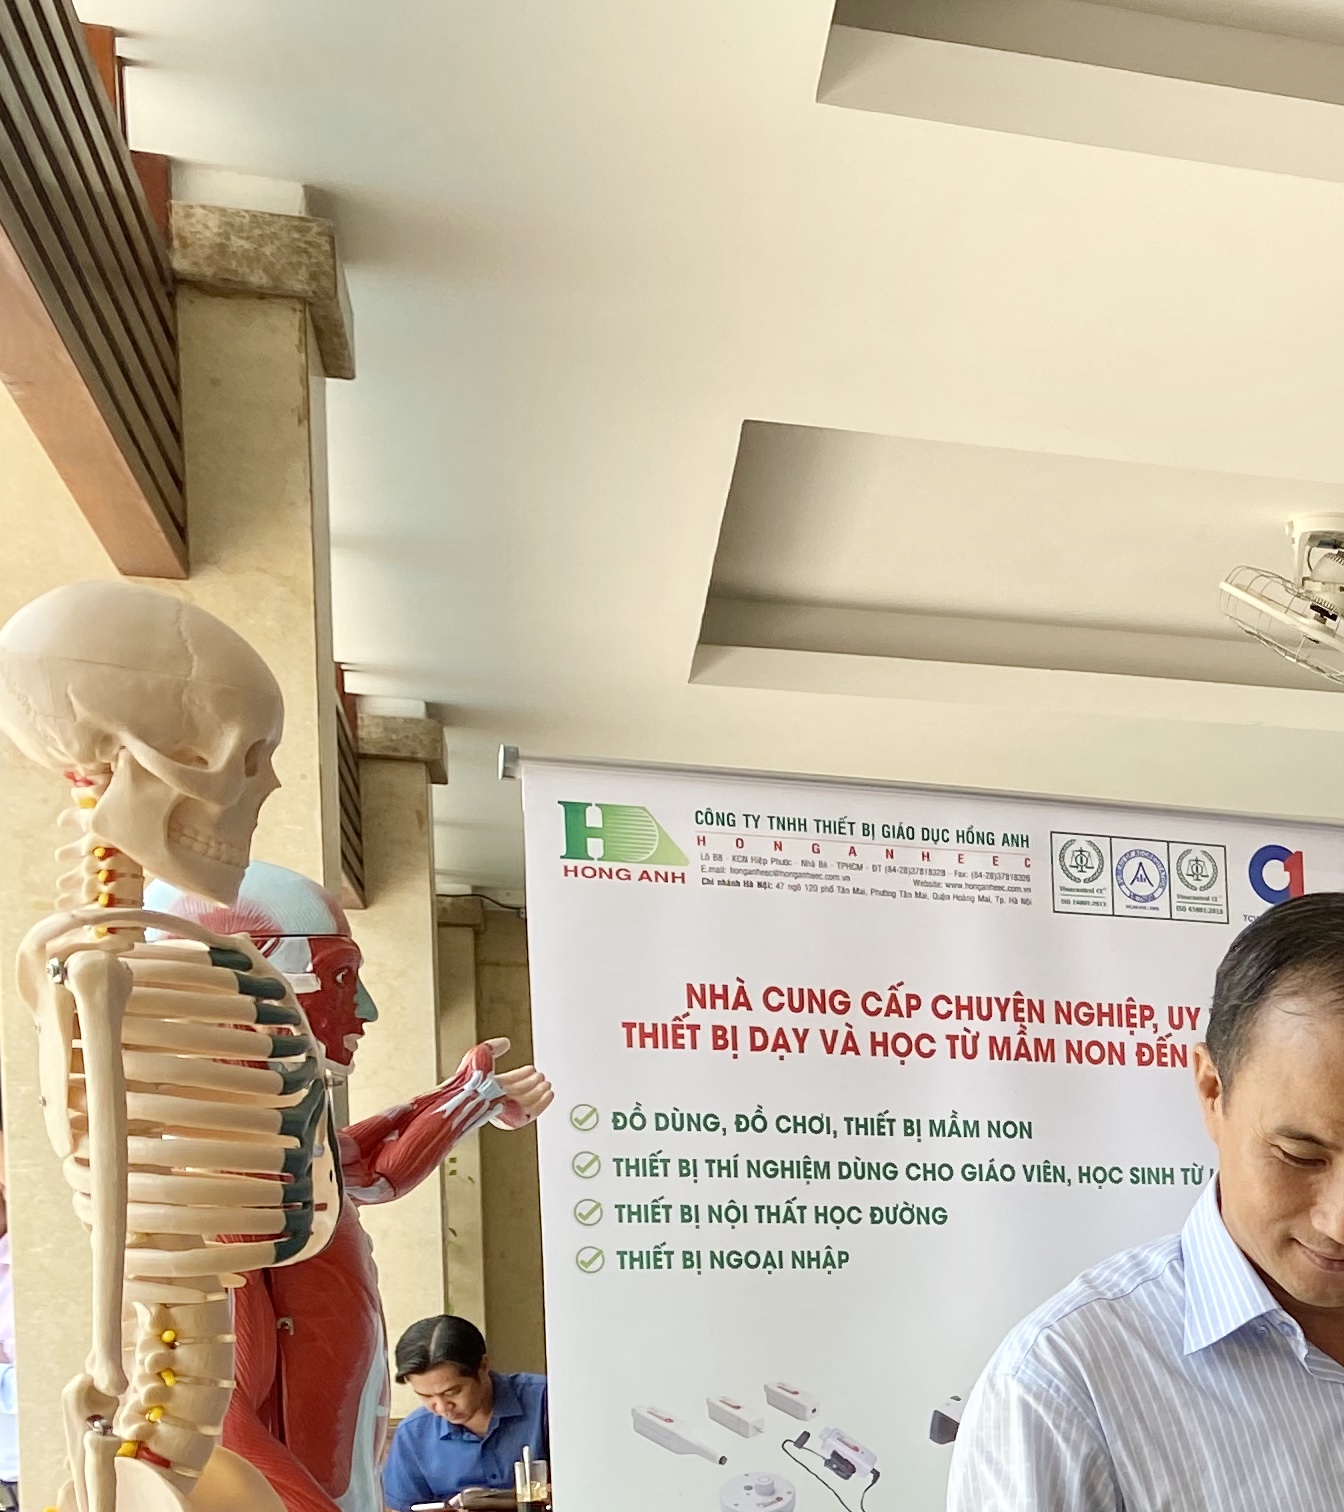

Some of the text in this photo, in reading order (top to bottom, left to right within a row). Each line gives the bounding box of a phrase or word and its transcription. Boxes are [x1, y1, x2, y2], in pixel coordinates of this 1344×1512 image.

[695, 807, 736, 827] CÔNG
[742, 814, 760, 829] TY
[767, 815, 808, 832] TNHH
[813, 816, 856, 836] THIẾT
[862, 823, 875, 841] BỊ
[882, 822, 915, 841] GIÁO
[921, 827, 950, 845] DỤC
[1001, 833, 1030, 848] ANH
[563, 865, 686, 884] HONG ANH
[686, 976, 1201, 1036] NHÀ CUNG CẤP CHUYÊN NGHIỆP, UY
[621, 1011, 1188, 1068] THIẾT BỊ DẠY VÀ HỌC TỪ MẦM NON ĐẾN
[611, 1101, 1033, 1143] ĐỒ DÙNG, ĐỒ CHƠI, THIẾT BỊ MẦM NON
[612, 1149, 671, 1178] THIẾT
[678, 1158, 698, 1184] BỊ
[705, 1153, 739, 1179] THÍ
[746, 1155, 831, 1185] NGHIỆM
[838, 1156, 899, 1182] DÙNG
[905, 1162, 954, 1182] CHO
[960, 1158, 1016, 1182] GIÁO
[1022, 1160, 1072, 1187] VIÊN,
[1078, 1165, 1124, 1190] HỌC
[1129, 1166, 1175, 1186] SINH
[1180, 1162, 1205, 1186] TỪ
[614, 1195, 949, 1230] THIẾT BỊ NỘI THẤT HỌC ĐƯỜNG
[616, 1241, 850, 1275] THIẾT BỊ NGOẠI NHẬP
